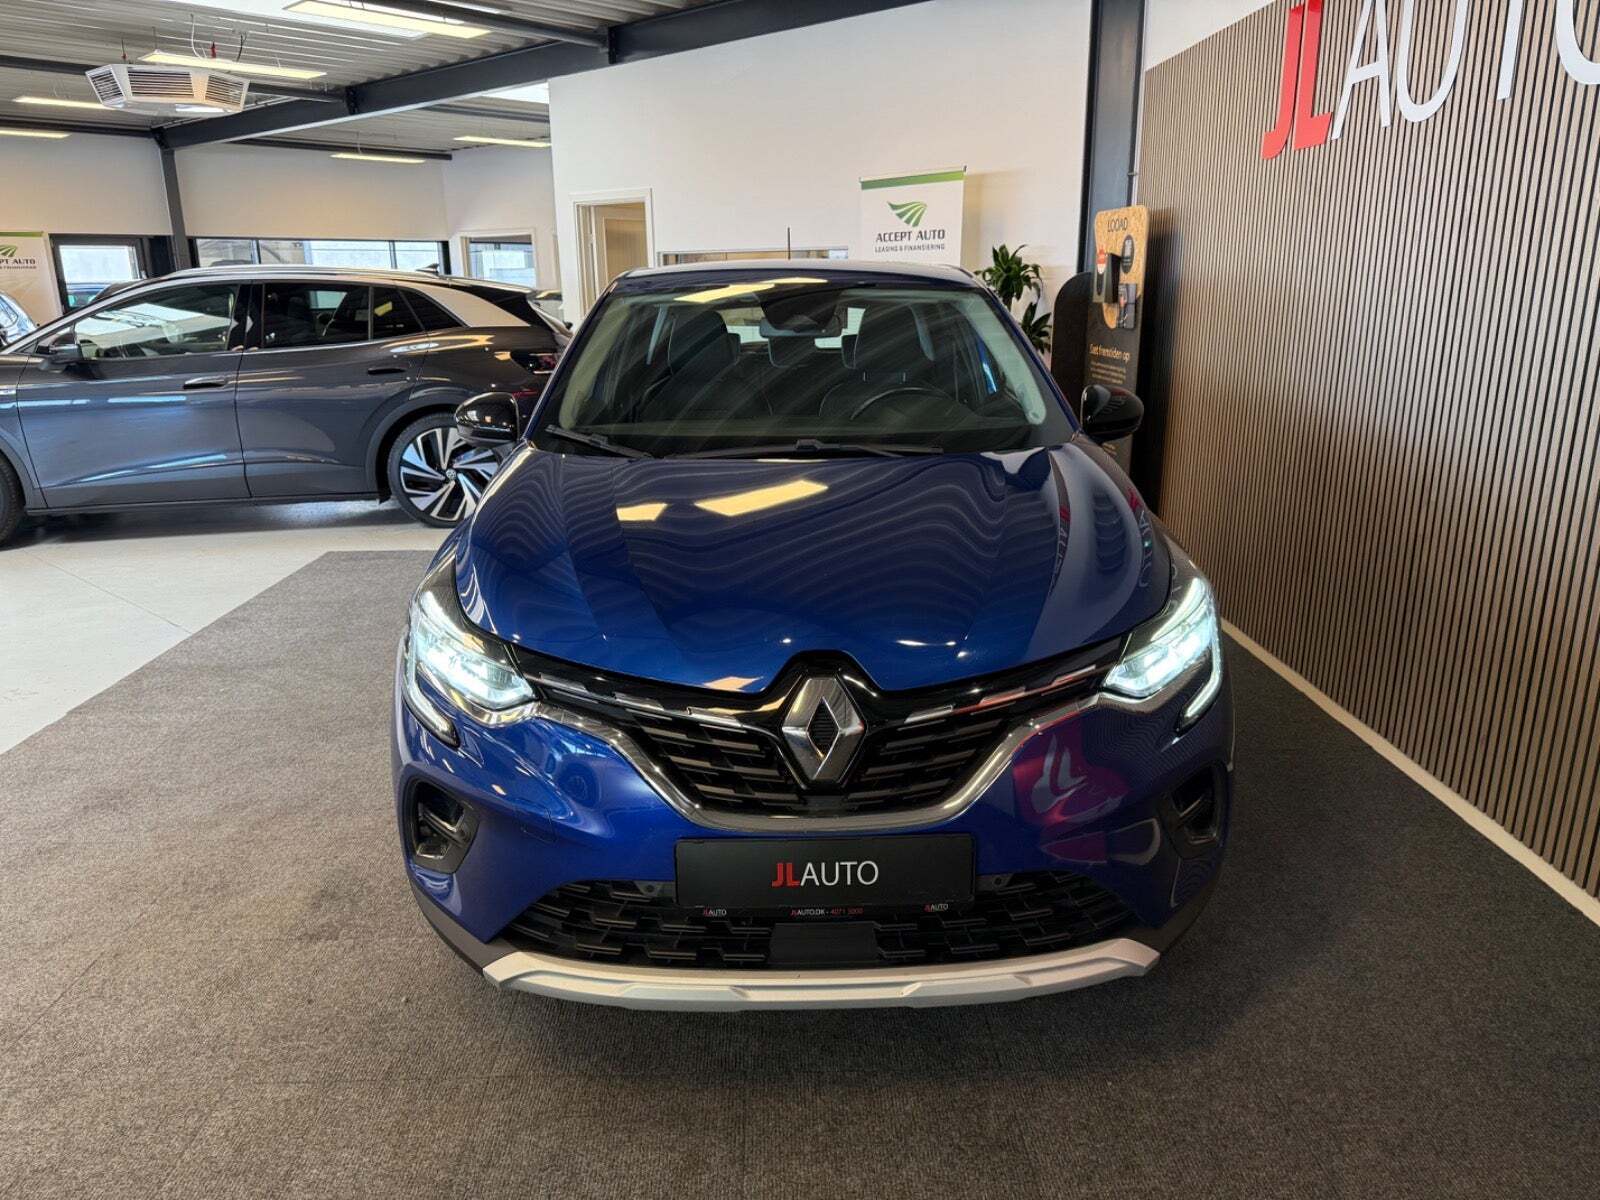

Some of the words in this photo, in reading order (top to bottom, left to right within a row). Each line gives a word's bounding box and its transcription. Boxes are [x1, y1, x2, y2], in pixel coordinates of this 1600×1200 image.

[876, 231, 912, 242] ACCEPT
[916, 229, 945, 240] AUTO
[904, 243, 945, 252] FINANSIERING
[771, 860, 879, 888] JLAUTO
